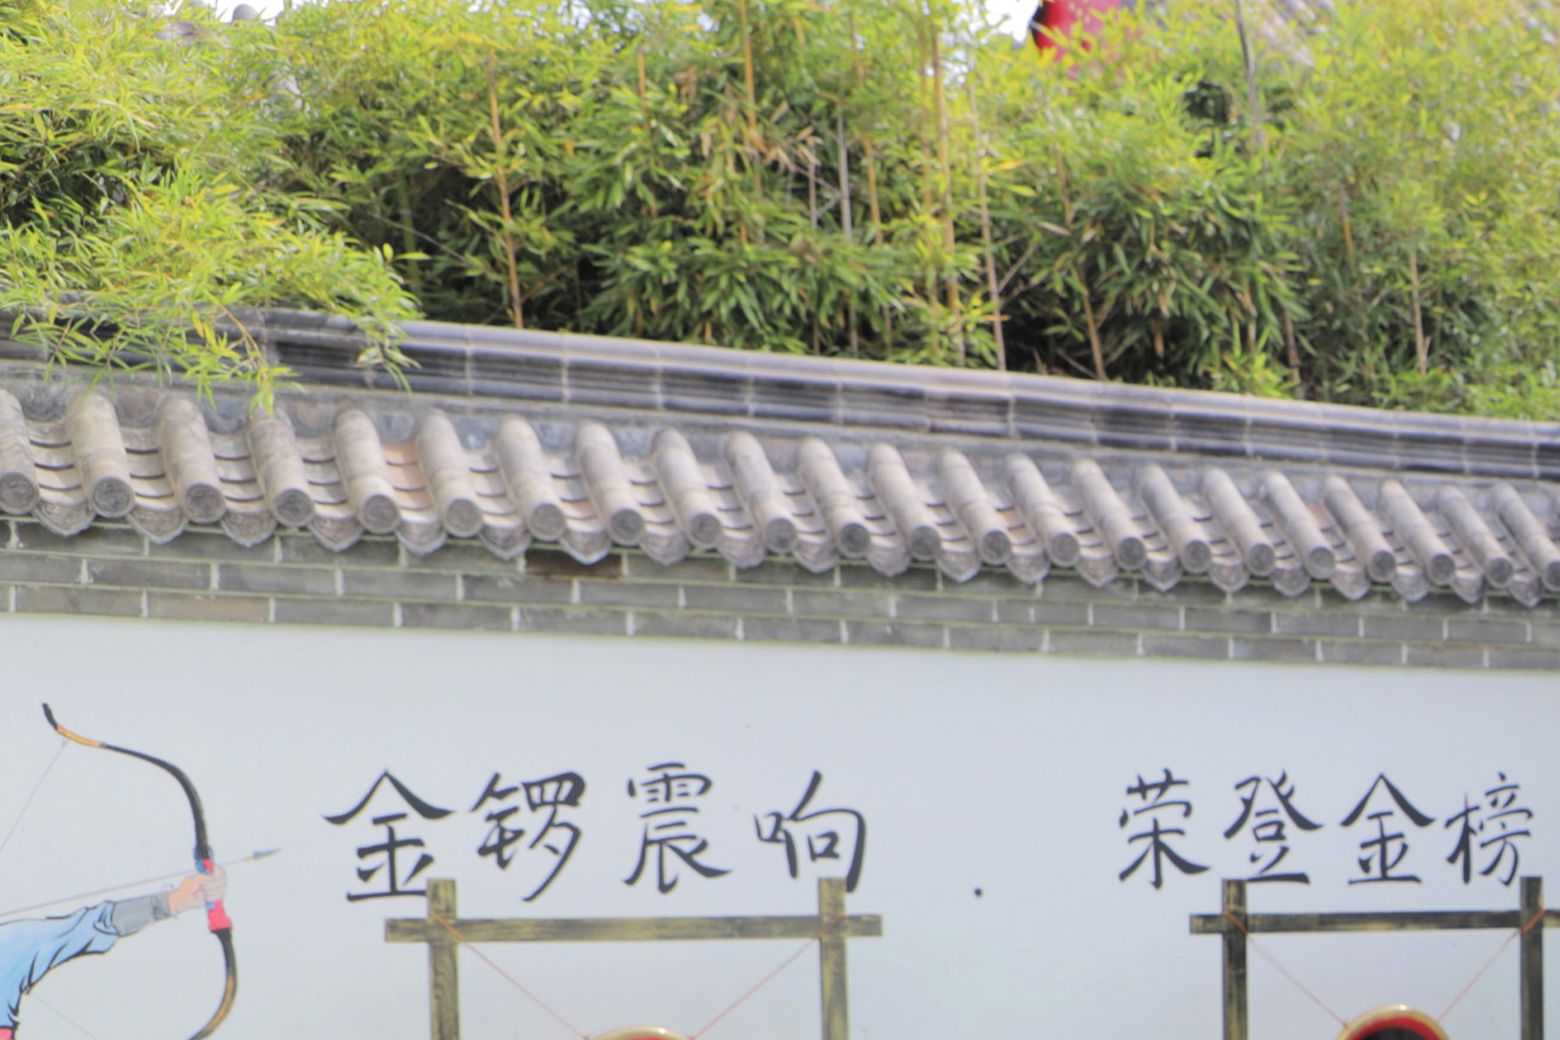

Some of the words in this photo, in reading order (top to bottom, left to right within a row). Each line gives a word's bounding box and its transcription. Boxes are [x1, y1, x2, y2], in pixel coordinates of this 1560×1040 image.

[322, 761, 867, 903] 金锣震响
[1119, 766, 1535, 889] 荣登金榜
